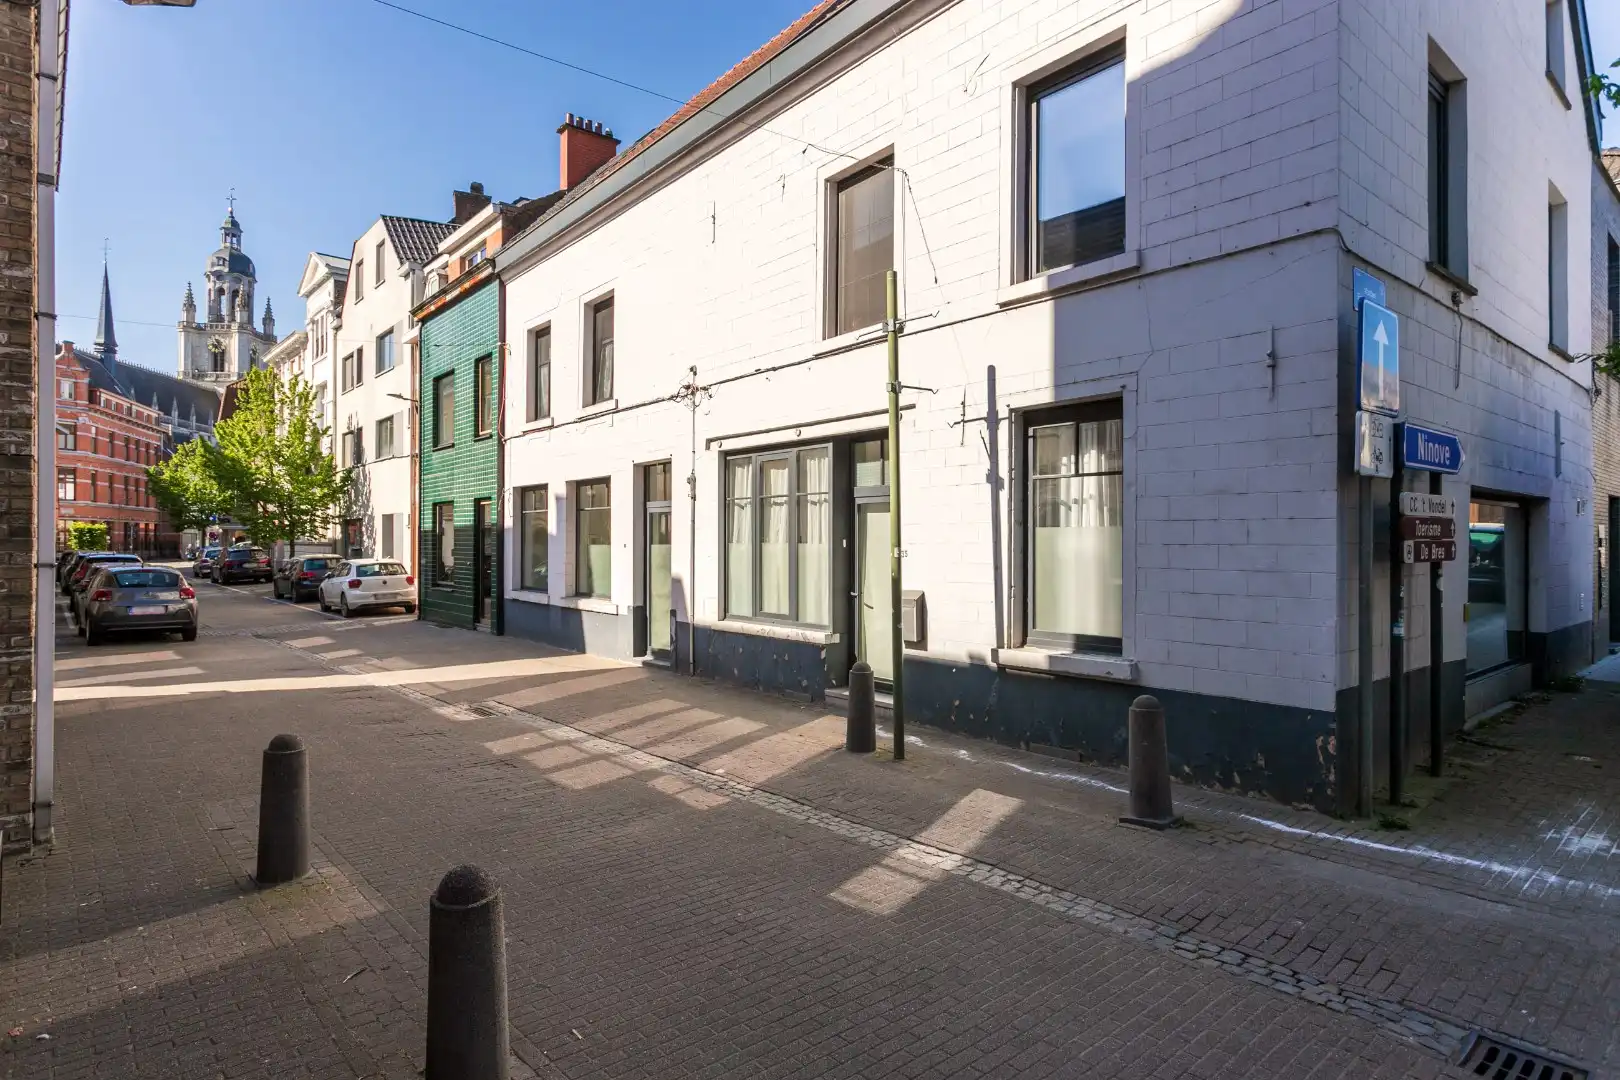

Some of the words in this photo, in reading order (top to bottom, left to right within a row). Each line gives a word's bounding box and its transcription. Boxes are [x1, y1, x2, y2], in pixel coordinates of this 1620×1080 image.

[1418, 432, 1450, 465] Ninove
[1410, 496, 1418, 512] CC
[1416, 520, 1441, 536] Toerisme
[1420, 543, 1429, 560] De
[1432, 544, 1444, 560] Bres
